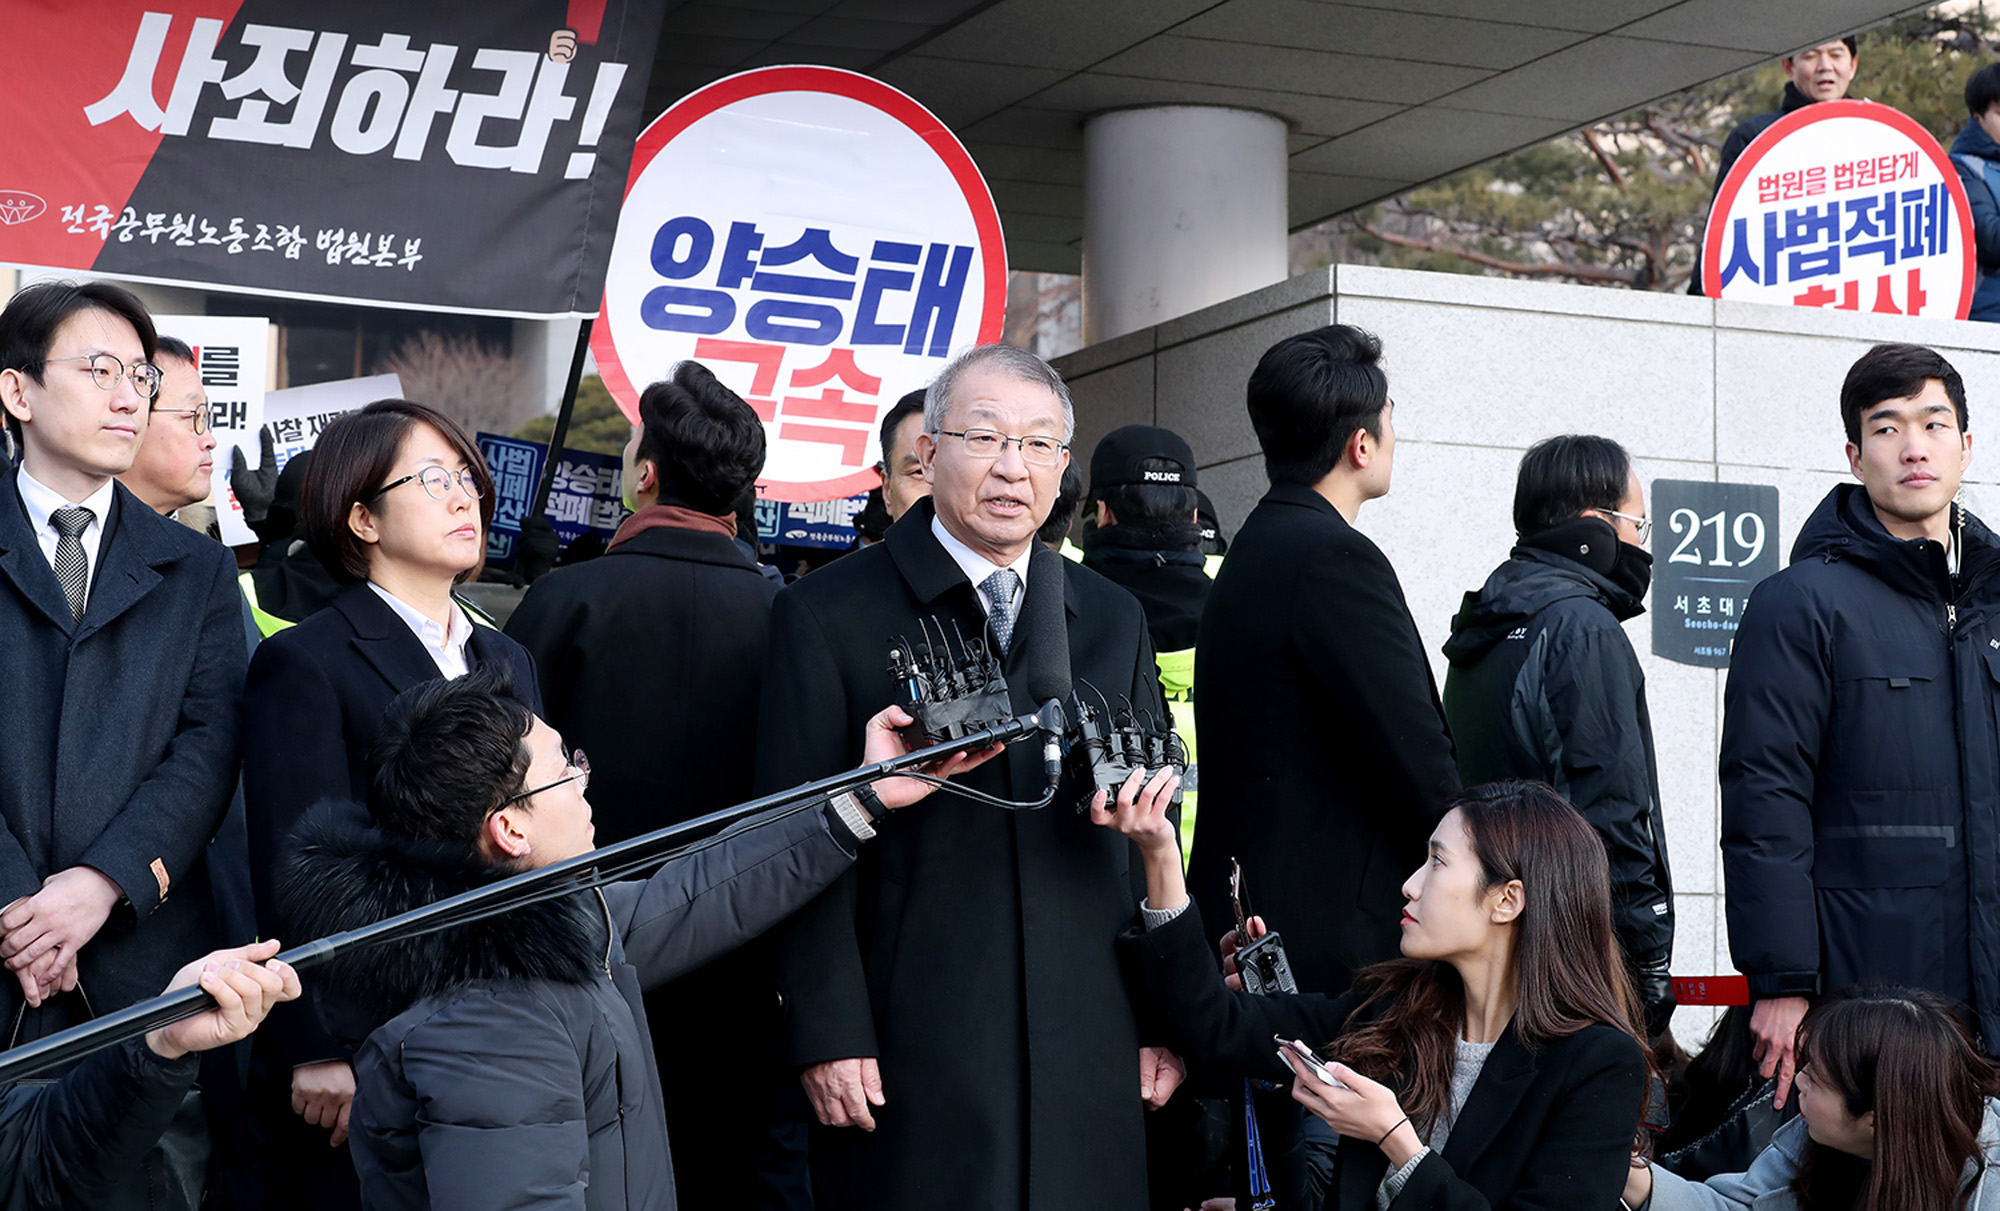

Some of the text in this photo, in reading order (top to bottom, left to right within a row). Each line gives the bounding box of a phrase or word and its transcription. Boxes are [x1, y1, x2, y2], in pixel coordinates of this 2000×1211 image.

[84, 11, 628, 180] 사죄하라!
[1758, 151, 1919, 205] 법원을 법원답게
[61, 203, 424, 271] 전국공무원노동조합 법원본부
[1721, 182, 1949, 288] 사법적폐
[640, 215, 974, 358] 양승태
[694, 337, 883, 467] 구속
[486, 444, 532, 476] 사법
[1144, 471, 1181, 482] POLICE
[1668, 508, 1766, 568] 219
